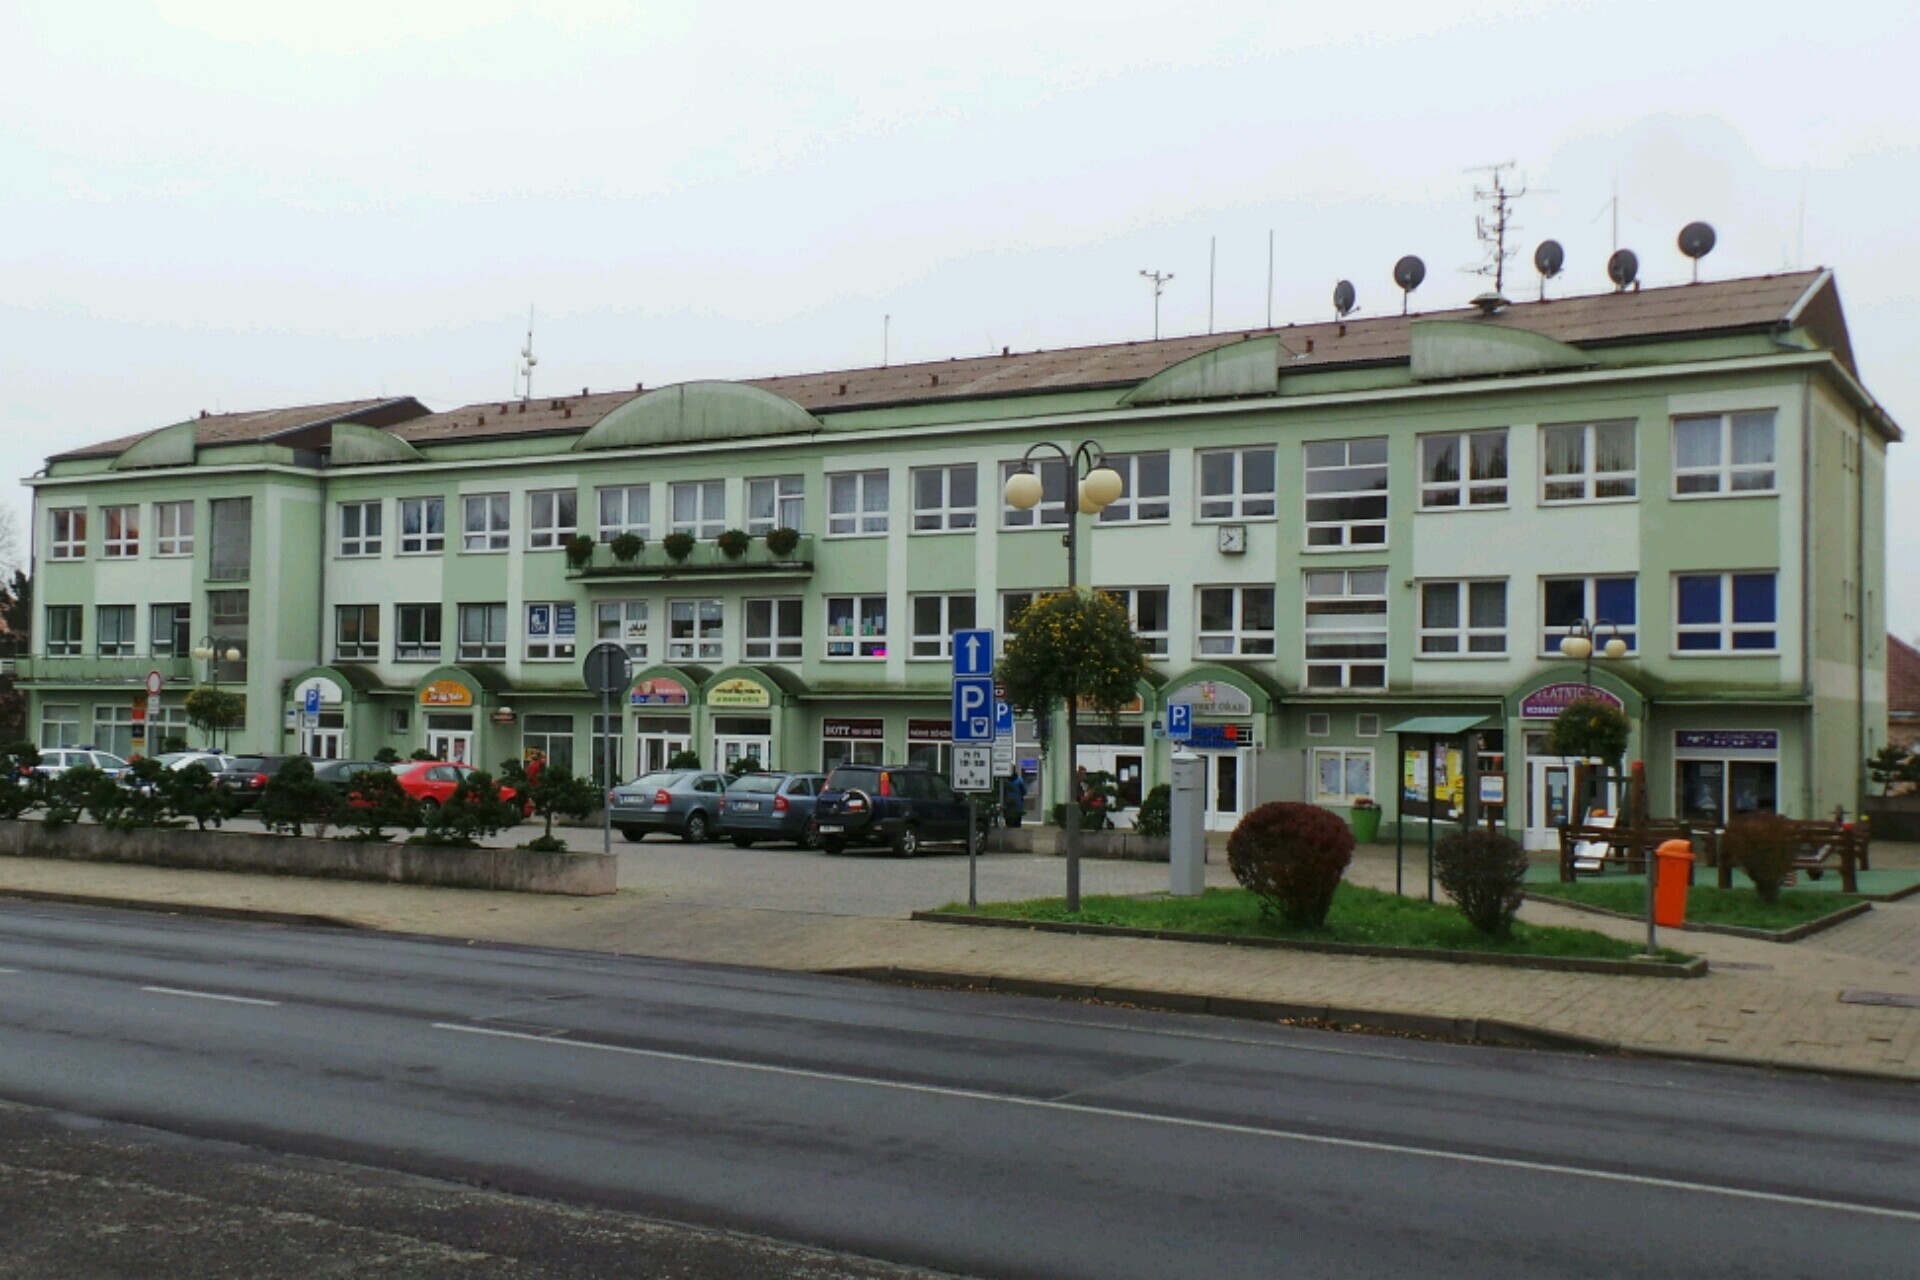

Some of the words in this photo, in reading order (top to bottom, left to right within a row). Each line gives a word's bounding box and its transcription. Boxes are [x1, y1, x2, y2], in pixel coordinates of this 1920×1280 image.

[962, 685, 985, 722] P
[997, 702, 1008, 722] P
[1172, 706, 1187, 727] P
